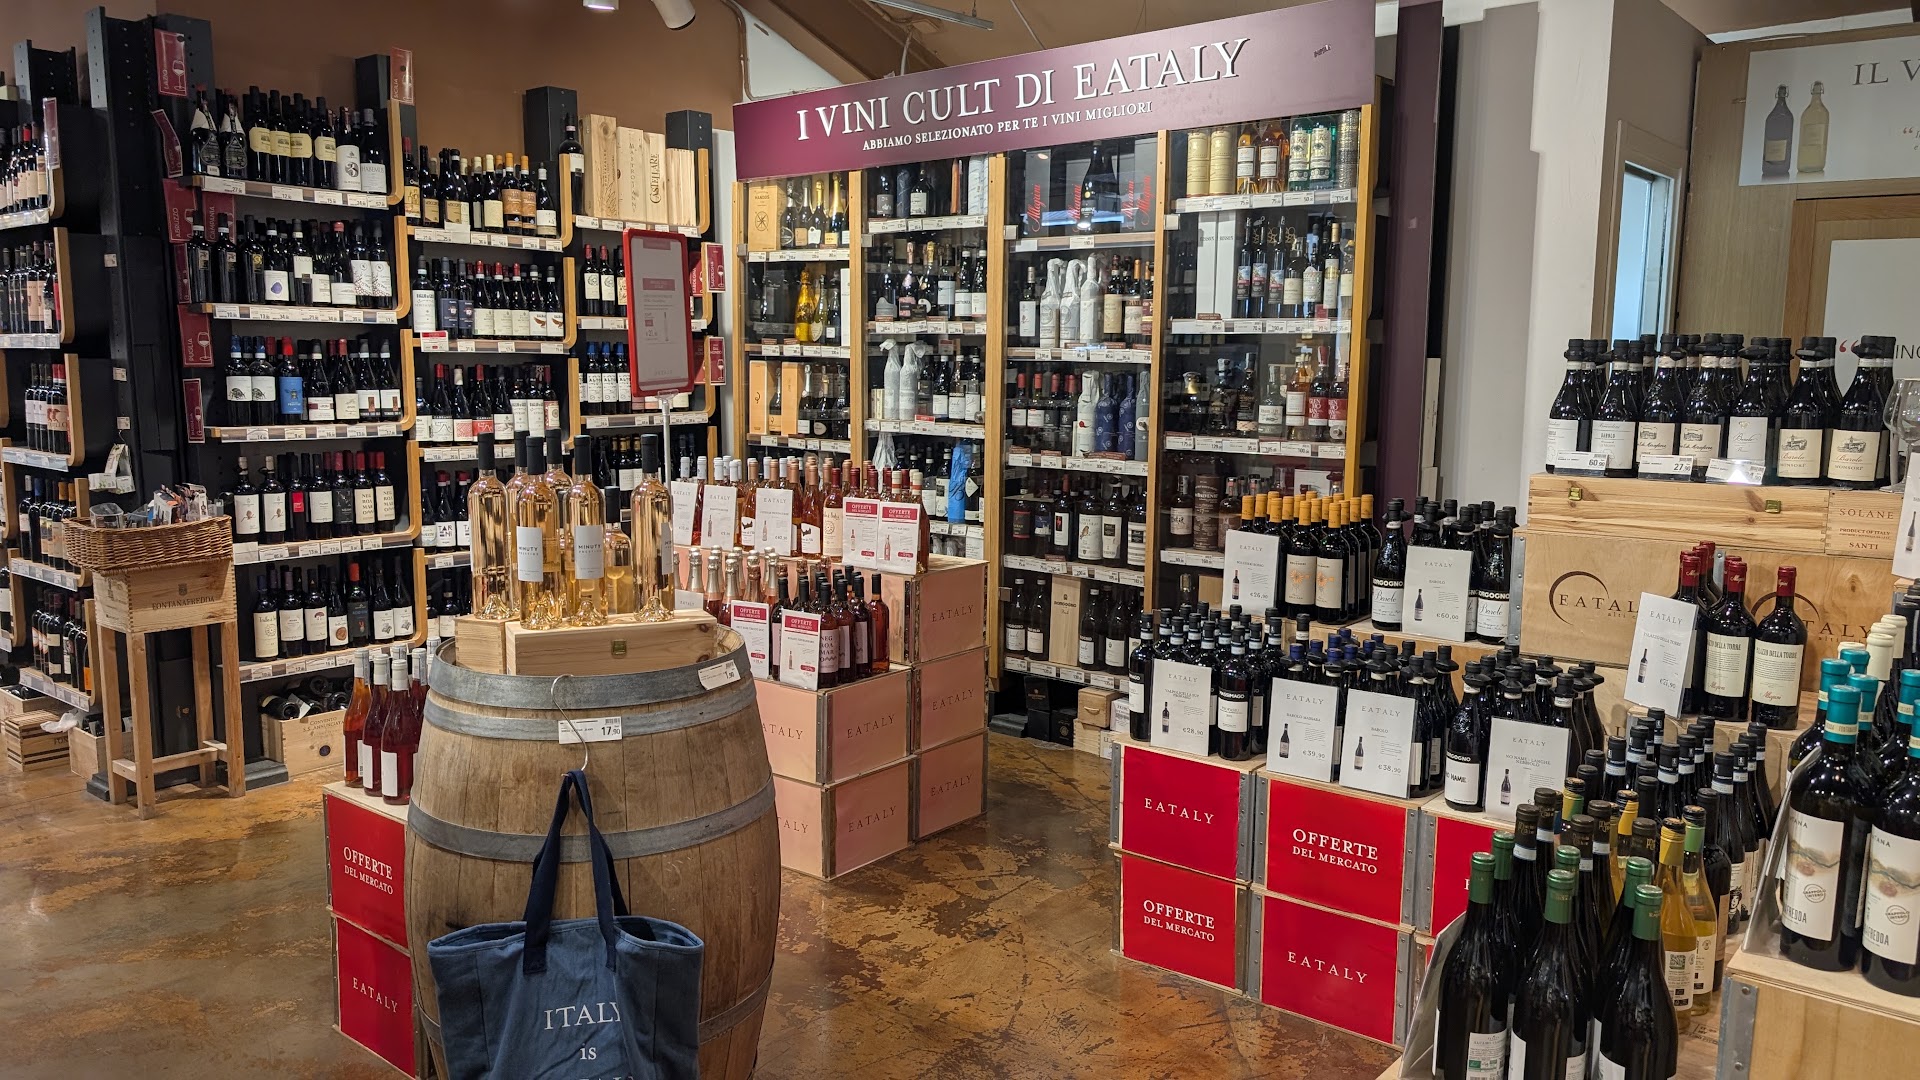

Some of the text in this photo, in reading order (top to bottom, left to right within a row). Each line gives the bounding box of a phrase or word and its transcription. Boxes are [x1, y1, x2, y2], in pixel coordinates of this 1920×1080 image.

[1852, 62, 1889, 86] IL
[796, 37, 1250, 141] I VINI CULT DI EATALY
[863, 101, 1153, 151] ABBIAMO SELEZIONATO PER TE I VINI MIGLIORI
[650, 153, 661, 204] CASTELLARE
[173, 207, 181, 238] ABRUZZO
[1835, 454, 1863, 463] Barolo
[1839, 508, 1894, 519] SOLANE
[1849, 542, 1879, 550] SANTI
[152, 596, 215, 610] FONTANAFREDDA
[932, 604, 975, 622] EATALY
[1558, 594, 1639, 613] EATAL
[791, 618, 813, 626] OFFERTE
[1650, 610, 1683, 625] EATALY
[1769, 648, 1782, 658] DELLA
[1168, 673, 1197, 683] EATALY
[932, 688, 975, 711] EATALY
[1286, 693, 1324, 705] EATALY
[310, 716, 337, 725] CONVENTO
[1361, 705, 1401, 717] EATALY
[761, 722, 804, 740] ATALY
[847, 714, 896, 739] EATALY
[1512, 737, 1546, 747] EATALY
[931, 773, 973, 797] EATALY
[847, 805, 897, 833] EATALY
[1144, 797, 1215, 825] EATALY
[777, 816, 809, 834] TALY
[1292, 828, 1379, 861] OFFERTE
[343, 846, 393, 881] OFFERTE
[1292, 845, 1378, 875] DEL MERCATO
[344, 865, 394, 896] DEL MERCATO
[1143, 899, 1215, 929] OFFERTE
[1143, 915, 1215, 942] DEL MERCATO
[1287, 951, 1368, 984] EATALY
[352, 976, 398, 1014] EATALY
[579, 1044, 597, 1060] is
